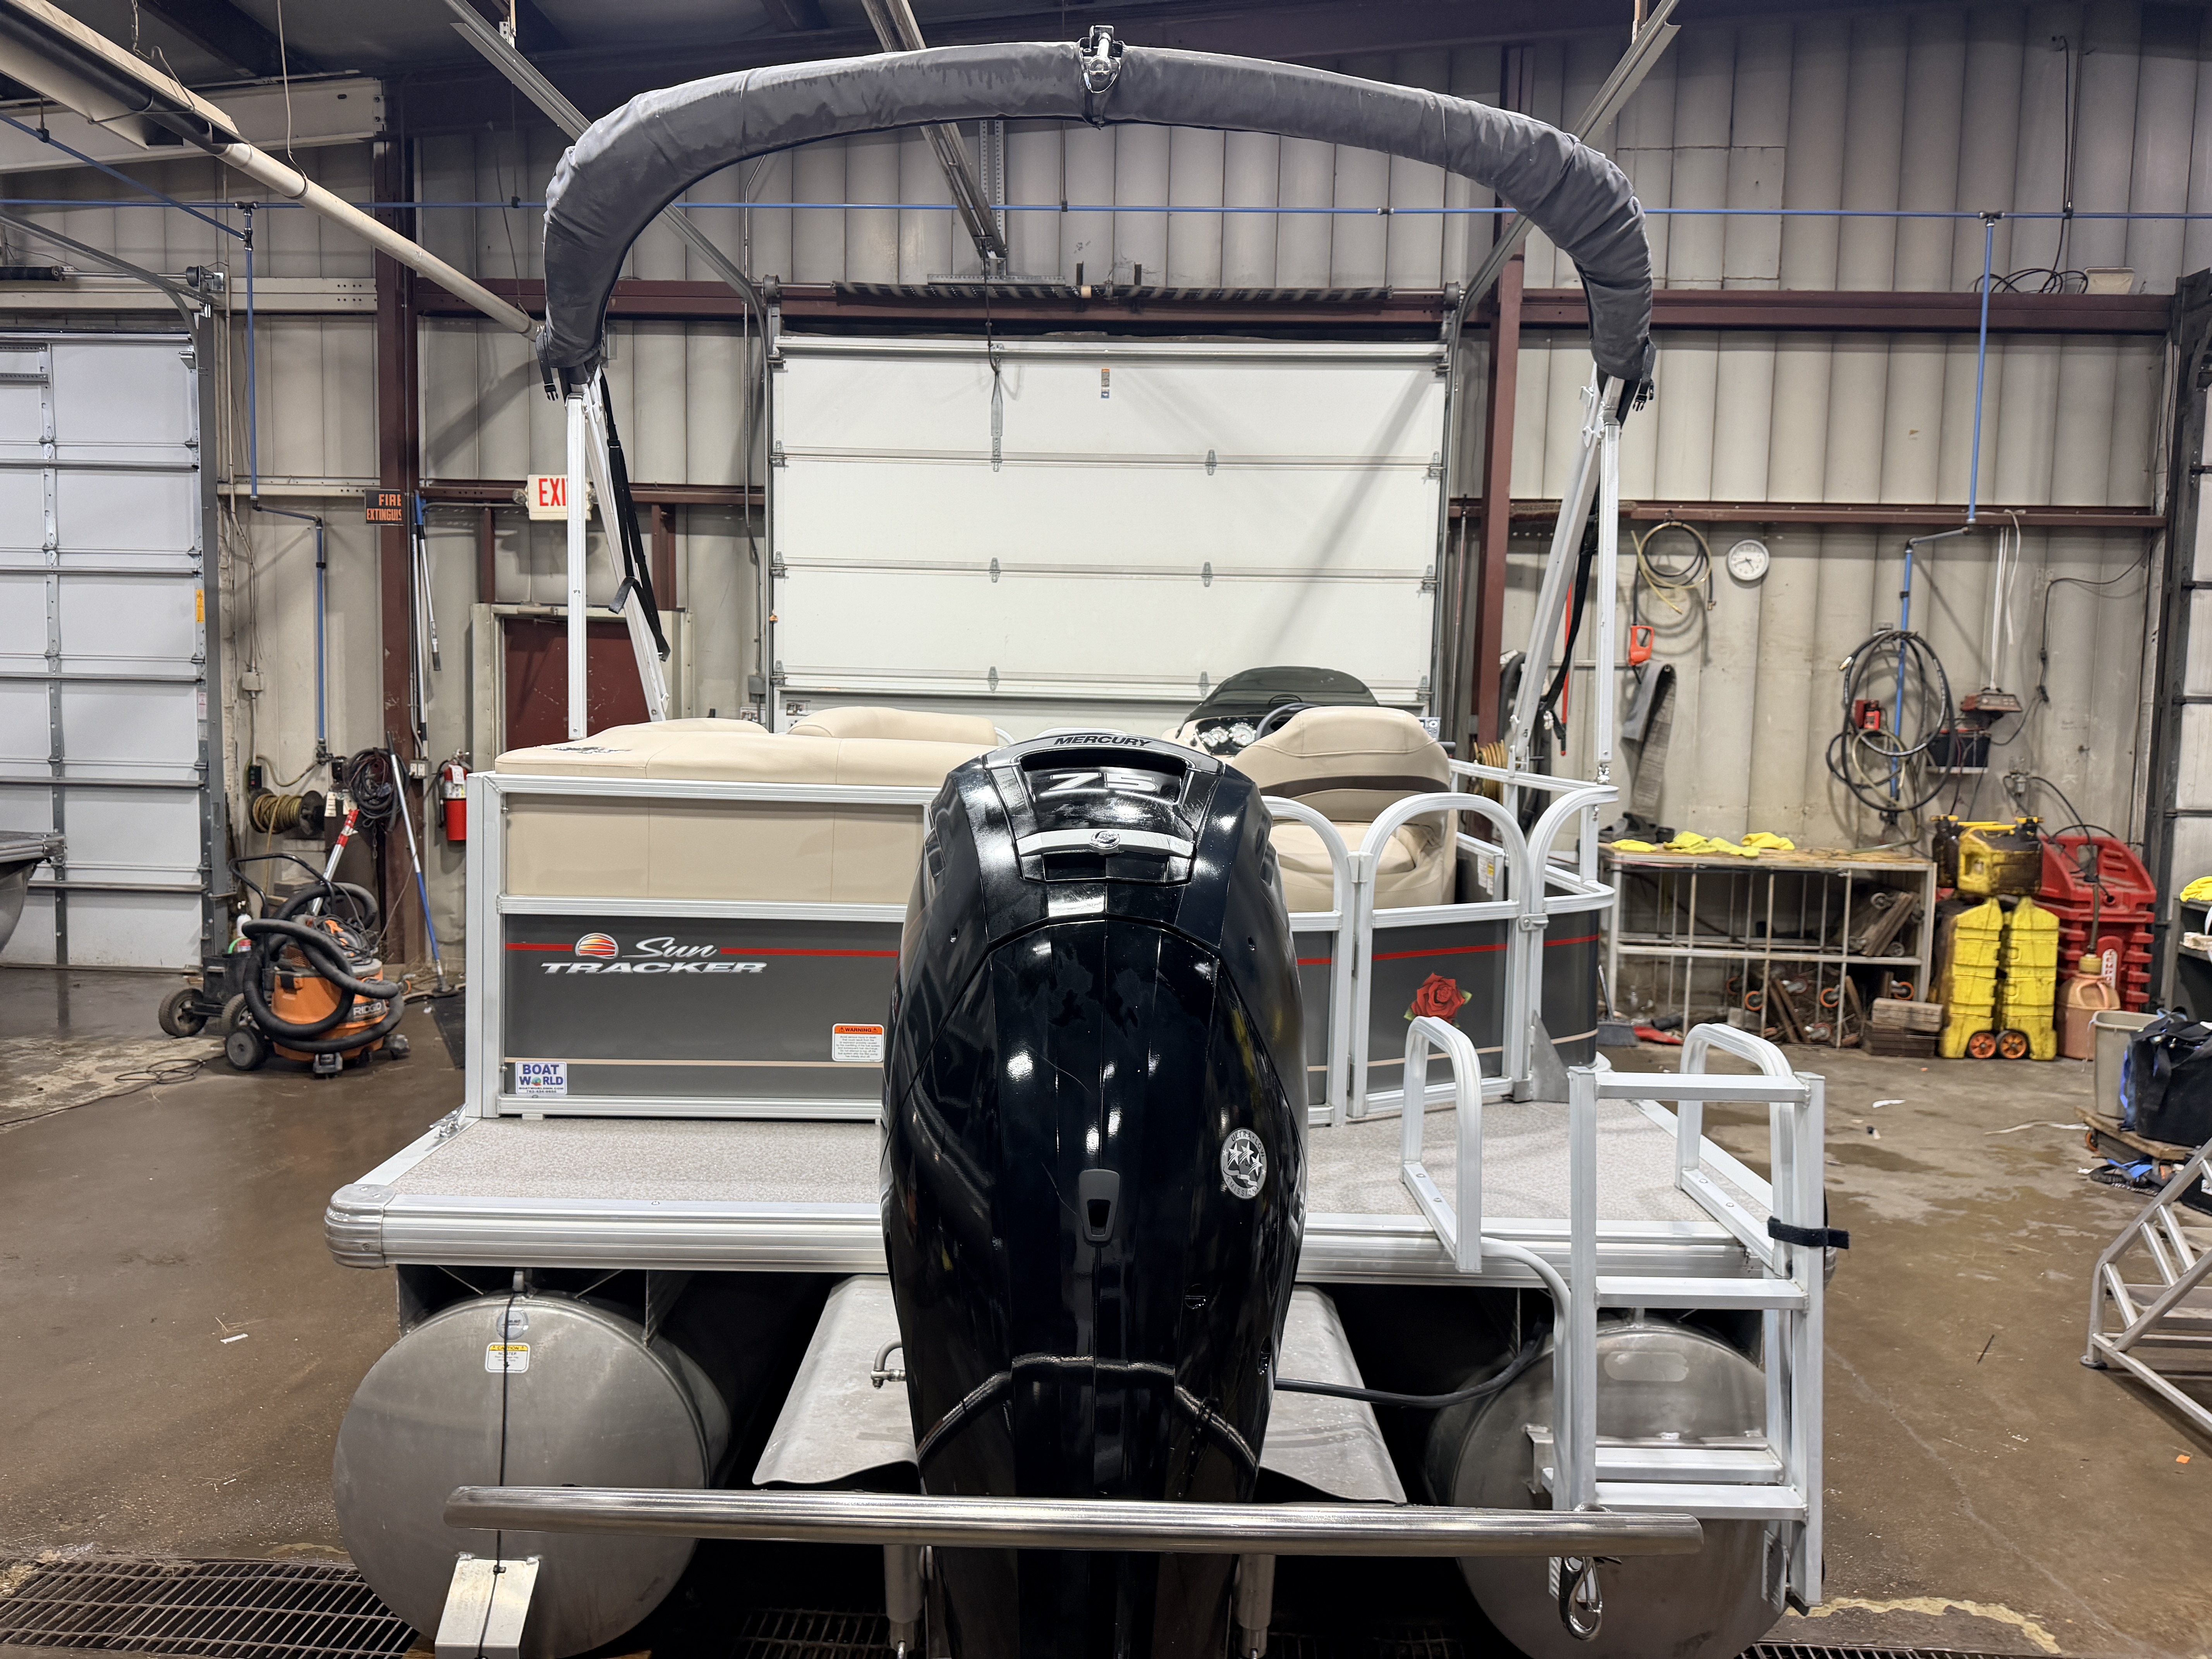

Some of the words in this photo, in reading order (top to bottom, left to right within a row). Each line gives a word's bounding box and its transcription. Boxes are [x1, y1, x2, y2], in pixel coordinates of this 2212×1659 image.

[539, 478, 568, 506] EXI
[379, 494, 402, 506] FIRE
[1053, 736, 1153, 747] MERCURY
[1049, 773, 1157, 791] 75
[622, 936, 717, 958] Sun
[541, 962, 768, 974] TRACKER
[522, 1064, 559, 1075] BOAT
[1231, 1131, 1251, 1142] ULTRA
[1255, 1139, 1265, 1157] LOW
